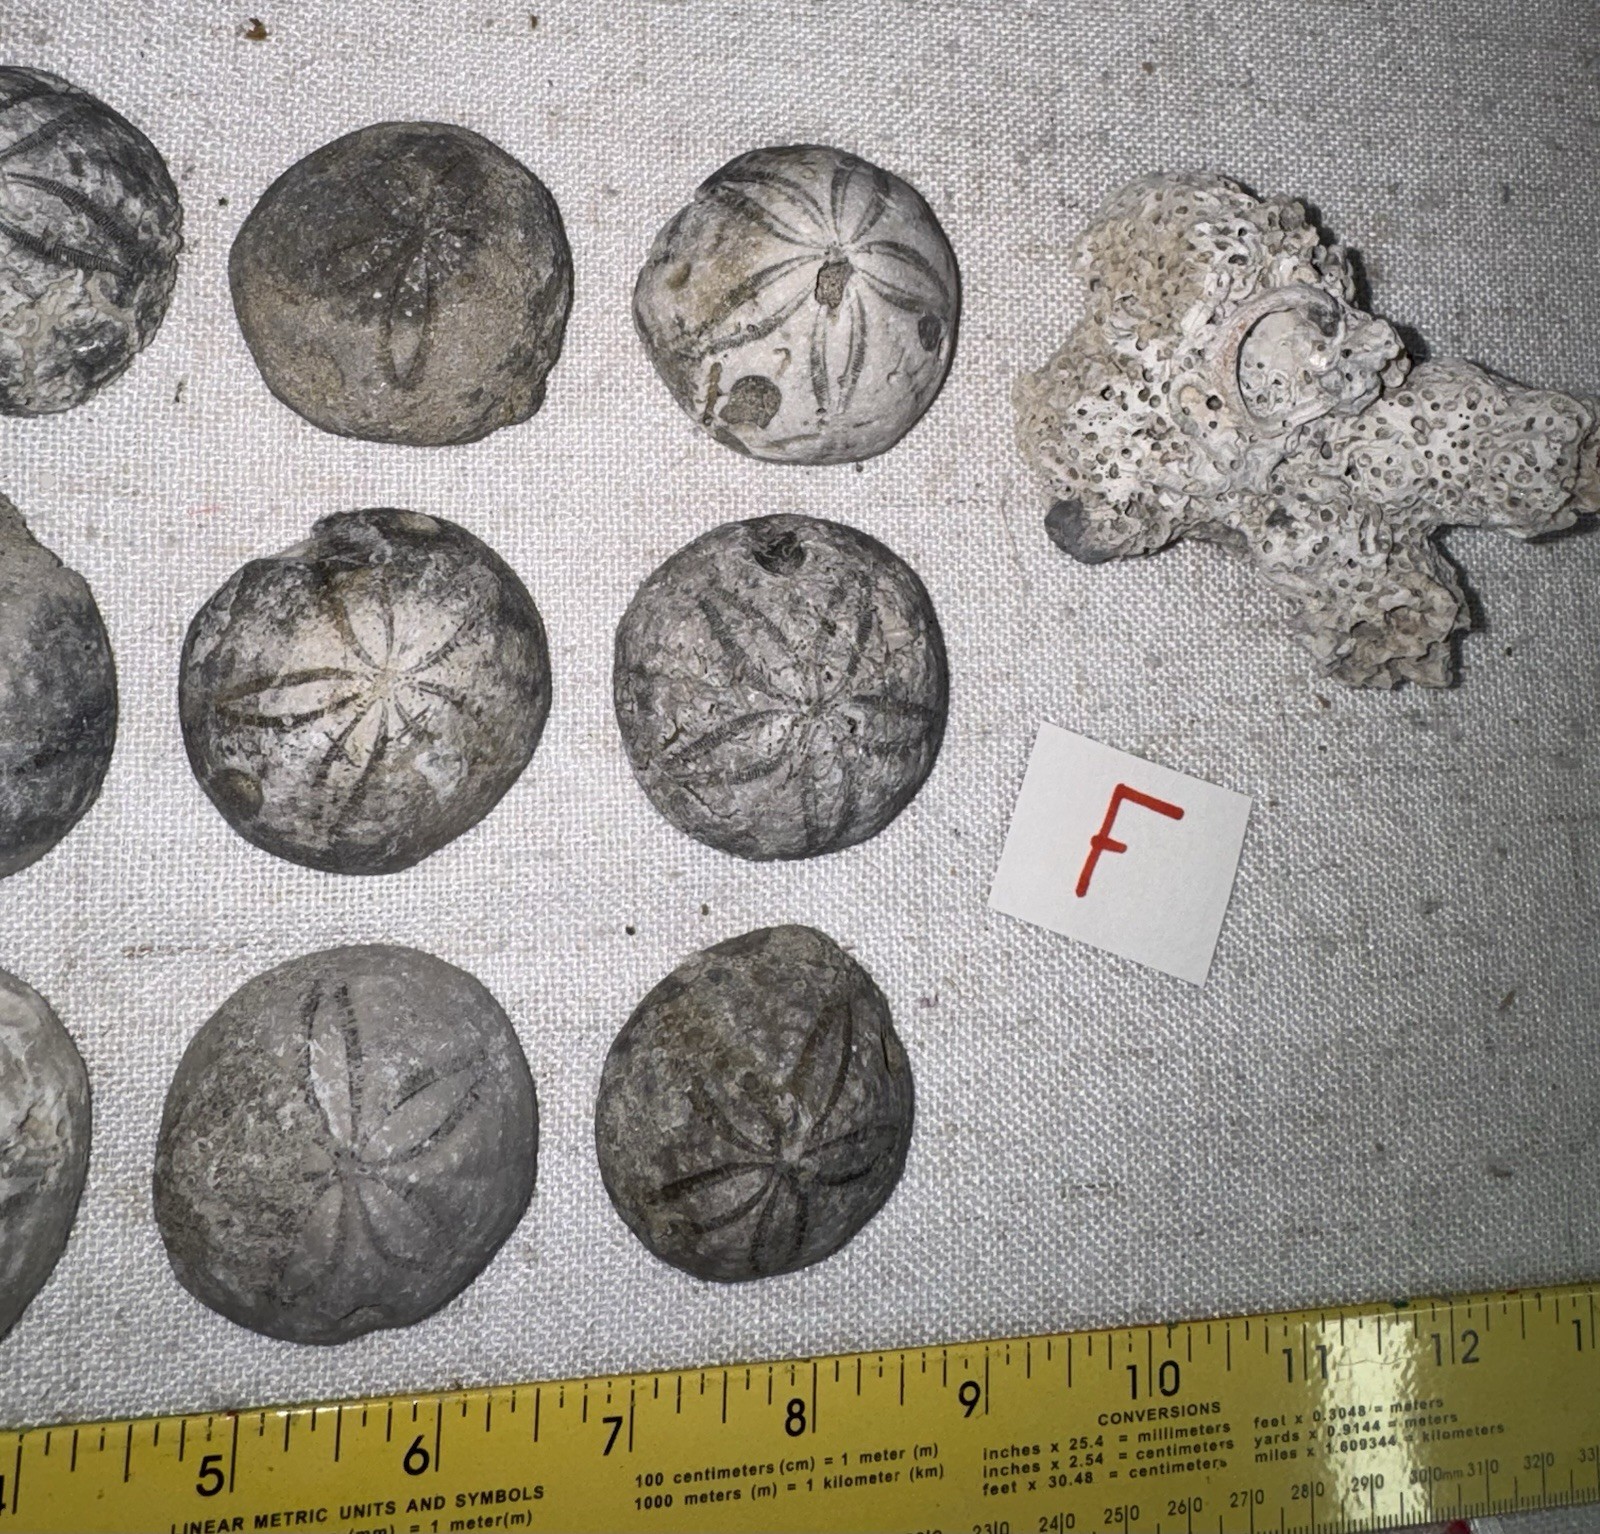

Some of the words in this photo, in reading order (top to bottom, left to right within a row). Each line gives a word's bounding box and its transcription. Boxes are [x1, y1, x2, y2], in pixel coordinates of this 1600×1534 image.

[1075, 783, 1184, 898] F
[195, 1454, 225, 1497] 5
[403, 1434, 430, 1476] 6
[602, 1416, 623, 1456] 7
[784, 1398, 807, 1437] 8
[958, 1380, 981, 1418] 9
[1126, 1360, 1180, 1400] 10
[1430, 1329, 1480, 1367] 12
[1097, 1400, 1222, 1427] CONVERSIONS
[1253, 1414, 1287, 1430] feet
[1295, 1414, 1303, 1425] x
[1312, 1405, 1366, 1423] 0.3048
[1374, 1404, 1383, 1414] =
[1390, 1398, 1444, 1414] meters
[1254, 1430, 1300, 1449] yards
[1309, 1430, 1317, 1441] x
[1327, 1420, 1381, 1438] 0.9144
[1404, 1413, 1459, 1429] meters
[982, 1442, 1042, 1461] inches
[1050, 1441, 1060, 1453] x
[1069, 1434, 1105, 1452] 25.4
[1119, 1434, 1129, 1443] =
[1137, 1422, 1232, 1444] millimeters
[982, 1460, 1042, 1479] inches
[1050, 1460, 1060, 1471] x
[1069, 1452, 1105, 1469] 2.54
[1119, 1452, 1129, 1461] =
[1135, 1438, 1235, 1461] centimeters
[1254, 1449, 1298, 1464] miles
[1307, 1448, 1315, 1458] x
[1422, 1422, 1506, 1444] kilometers
[635, 1473, 664, 1488] 100
[673, 1461, 775, 1484] centimeters
[779, 1455, 816, 1475] (cm)
[824, 1456, 834, 1466] =
[841, 1452, 848, 1466] 1
[859, 1449, 906, 1465] meter
[913, 1442, 939, 1461] (m)
[982, 1482, 1018, 1497] feet
[1028, 1480, 1037, 1492] x
[1048, 1471, 1095, 1489] 30.48
[1109, 1470, 1119, 1480] =
[634, 1493, 674, 1511] 1000
[684, 1488, 742, 1506] meters
[751, 1481, 778, 1501] (m)
[787, 1482, 797, 1491] =
[806, 1479, 814, 1492] 1
[823, 1469, 901, 1490] kilometer
[909, 1463, 945, 1483] (km)
[171, 1516, 244, 1534] LINEAR
[254, 1507, 328, 1529] METRIC
[339, 1500, 396, 1520] UNITS
[405, 1495, 446, 1513] AND
[455, 1484, 545, 1508] SYMBOLS
[430, 1519, 439, 1533] 1
[450, 1509, 533, 1532] meter(m)
